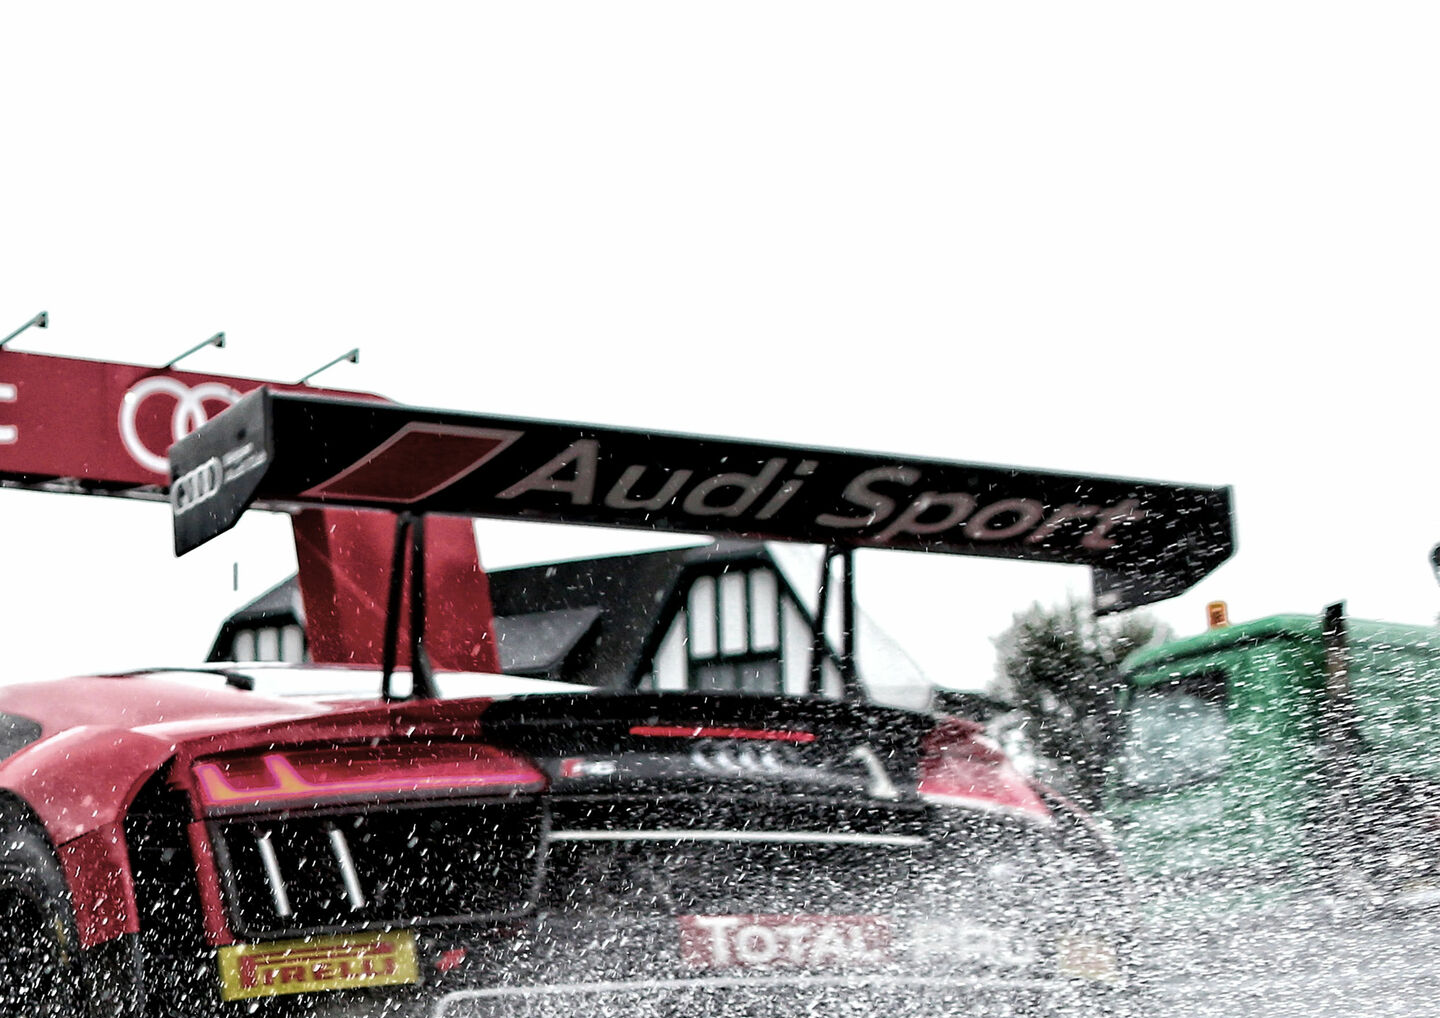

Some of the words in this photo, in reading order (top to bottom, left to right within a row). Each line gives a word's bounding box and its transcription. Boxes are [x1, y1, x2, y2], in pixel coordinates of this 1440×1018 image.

[496, 438, 819, 519] Audi
[814, 466, 1148, 549] Sport
[238, 942, 396, 989] PIRELLI
[695, 915, 881, 966] TOTAL
